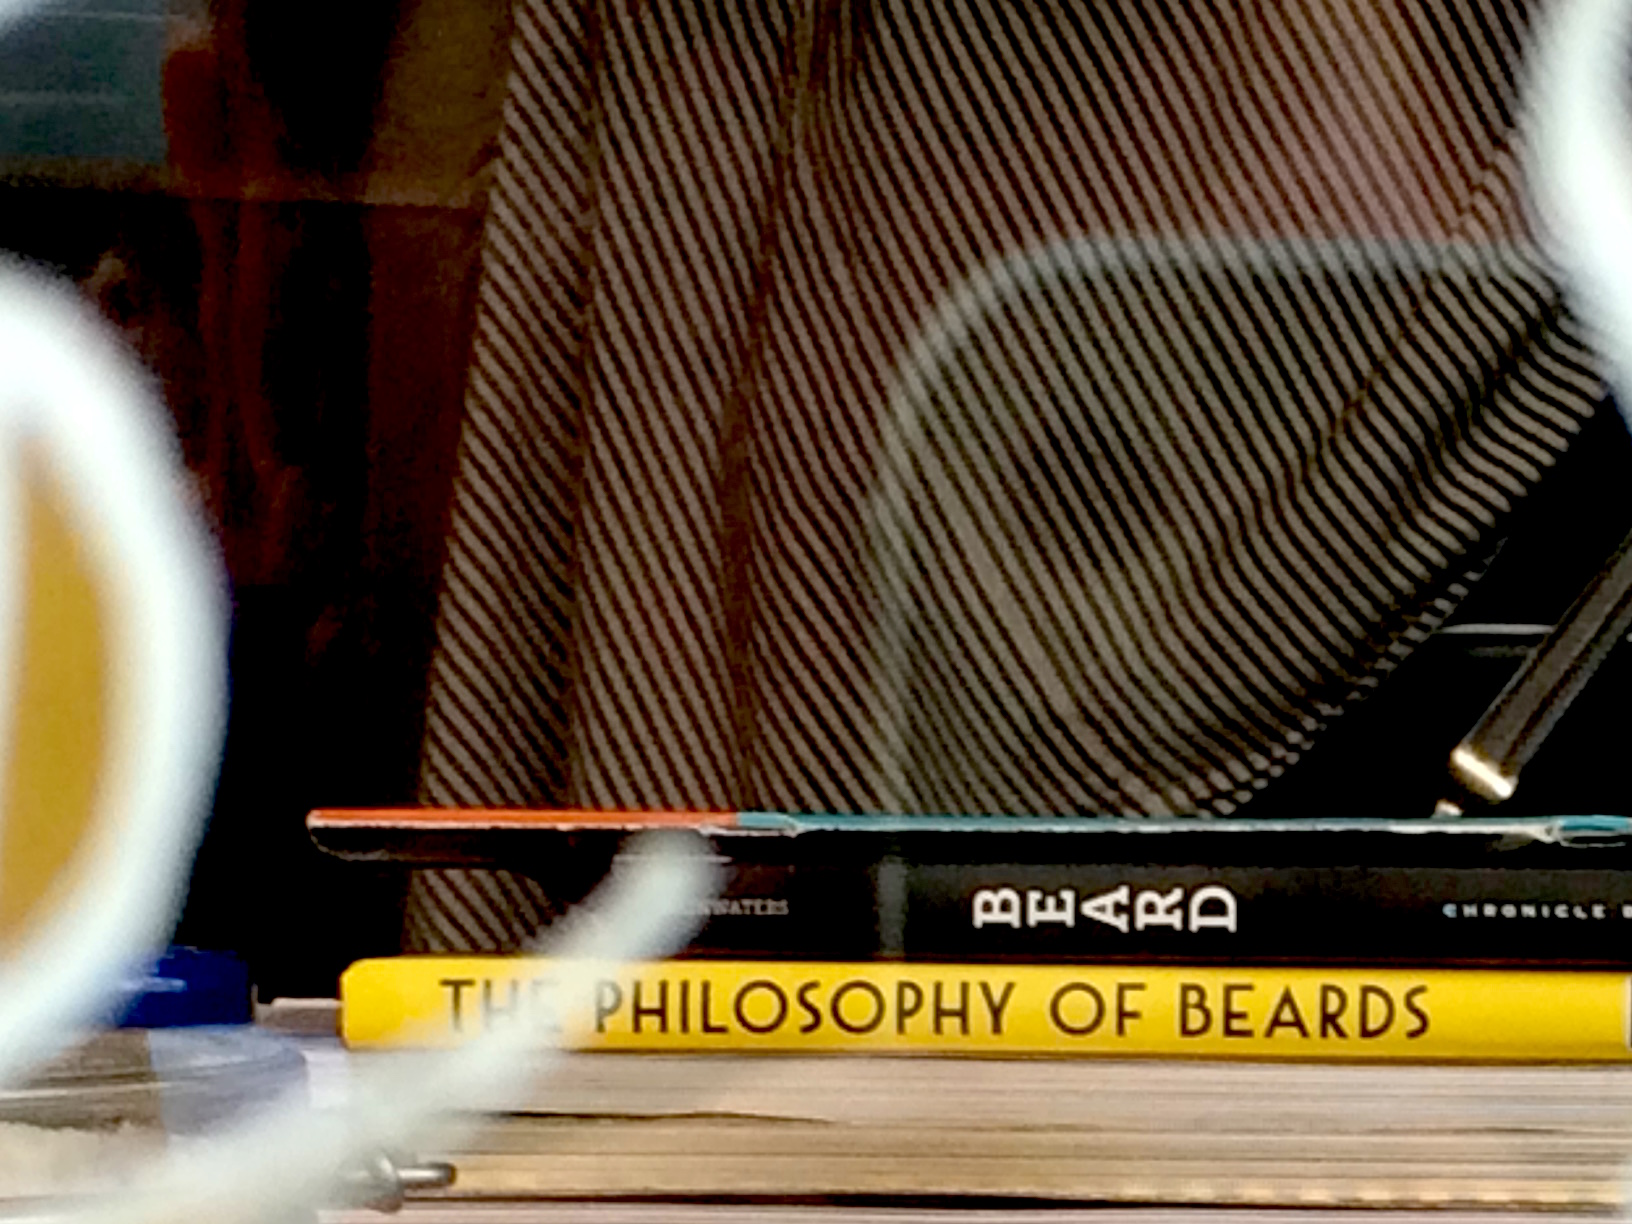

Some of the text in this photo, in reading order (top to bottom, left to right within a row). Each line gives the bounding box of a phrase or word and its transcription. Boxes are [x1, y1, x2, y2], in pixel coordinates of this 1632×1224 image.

[972, 885, 1238, 934] BEARD
[1442, 903, 1605, 920] CHRONICLE
[594, 980, 1016, 1035] PHILOSOPHY
[1049, 981, 1145, 1037] OF
[1178, 983, 1431, 1040] BEARDS
